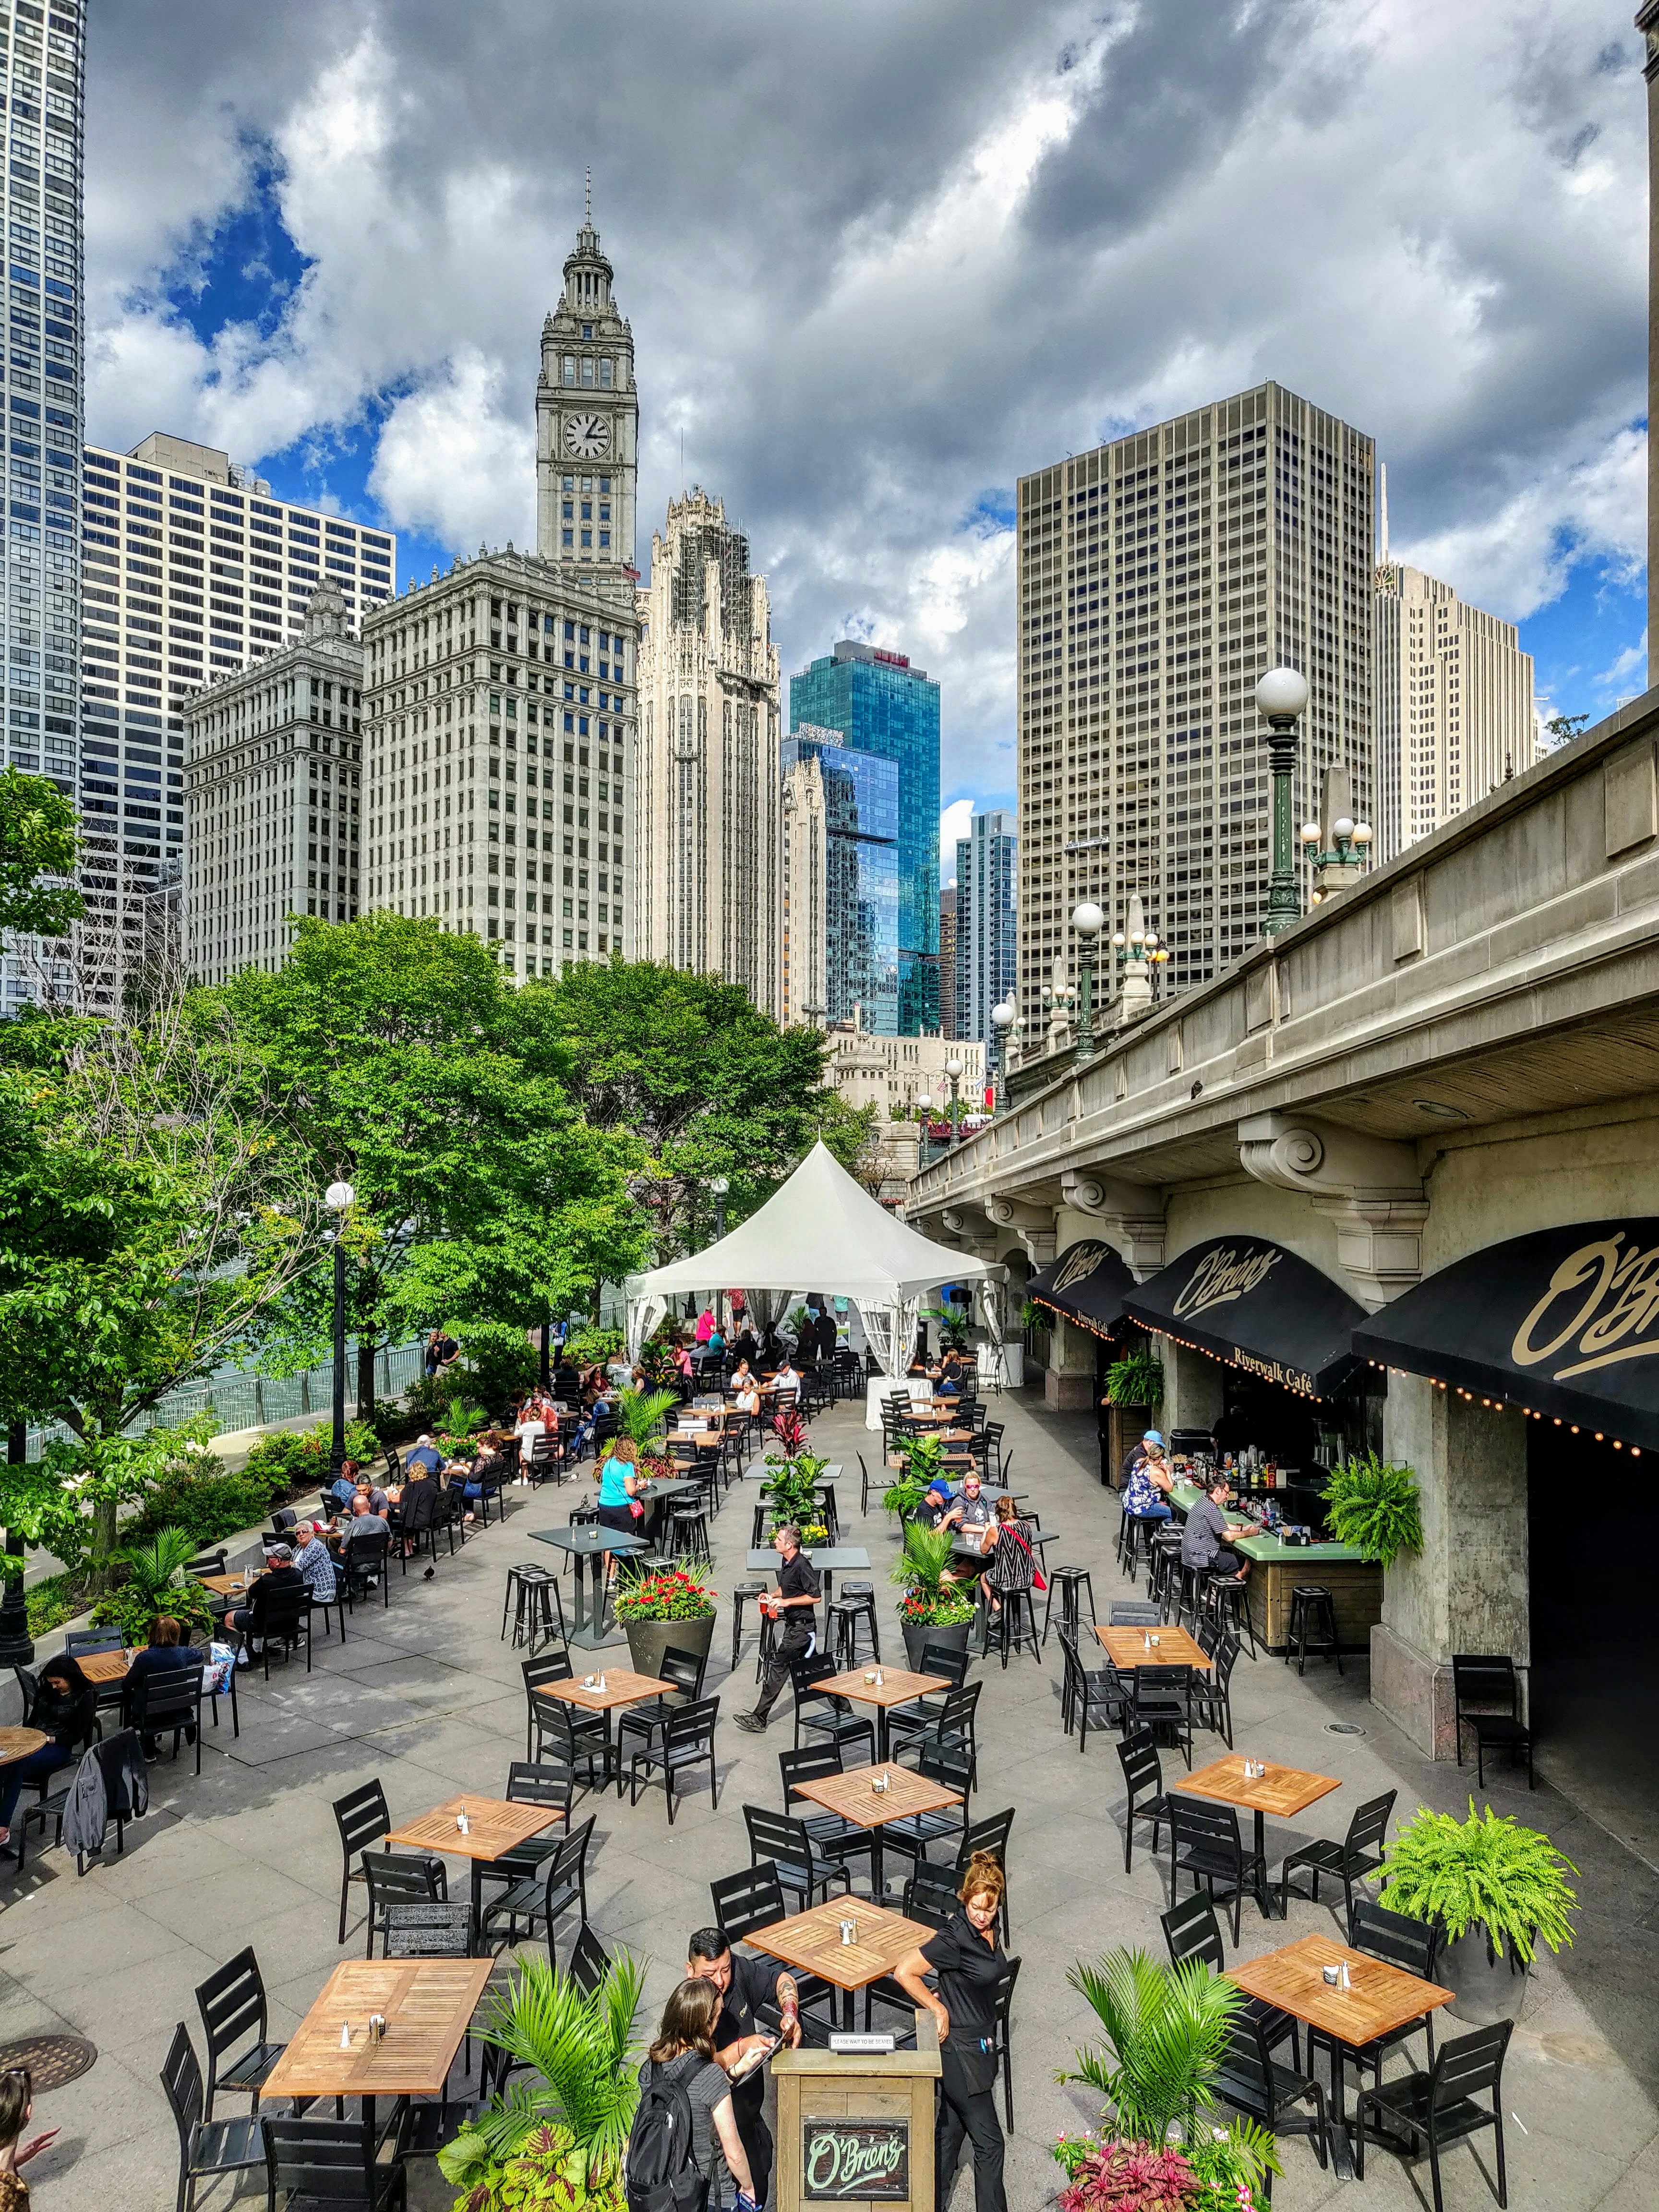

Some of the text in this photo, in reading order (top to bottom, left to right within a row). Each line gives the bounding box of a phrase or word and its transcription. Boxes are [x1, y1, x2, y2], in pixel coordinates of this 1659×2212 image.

[1077, 1309, 1108, 1334] Riverwalk Café
[1234, 1346, 1312, 1393] Riverwalk Café
[807, 2132, 906, 2190] O'Brien's
